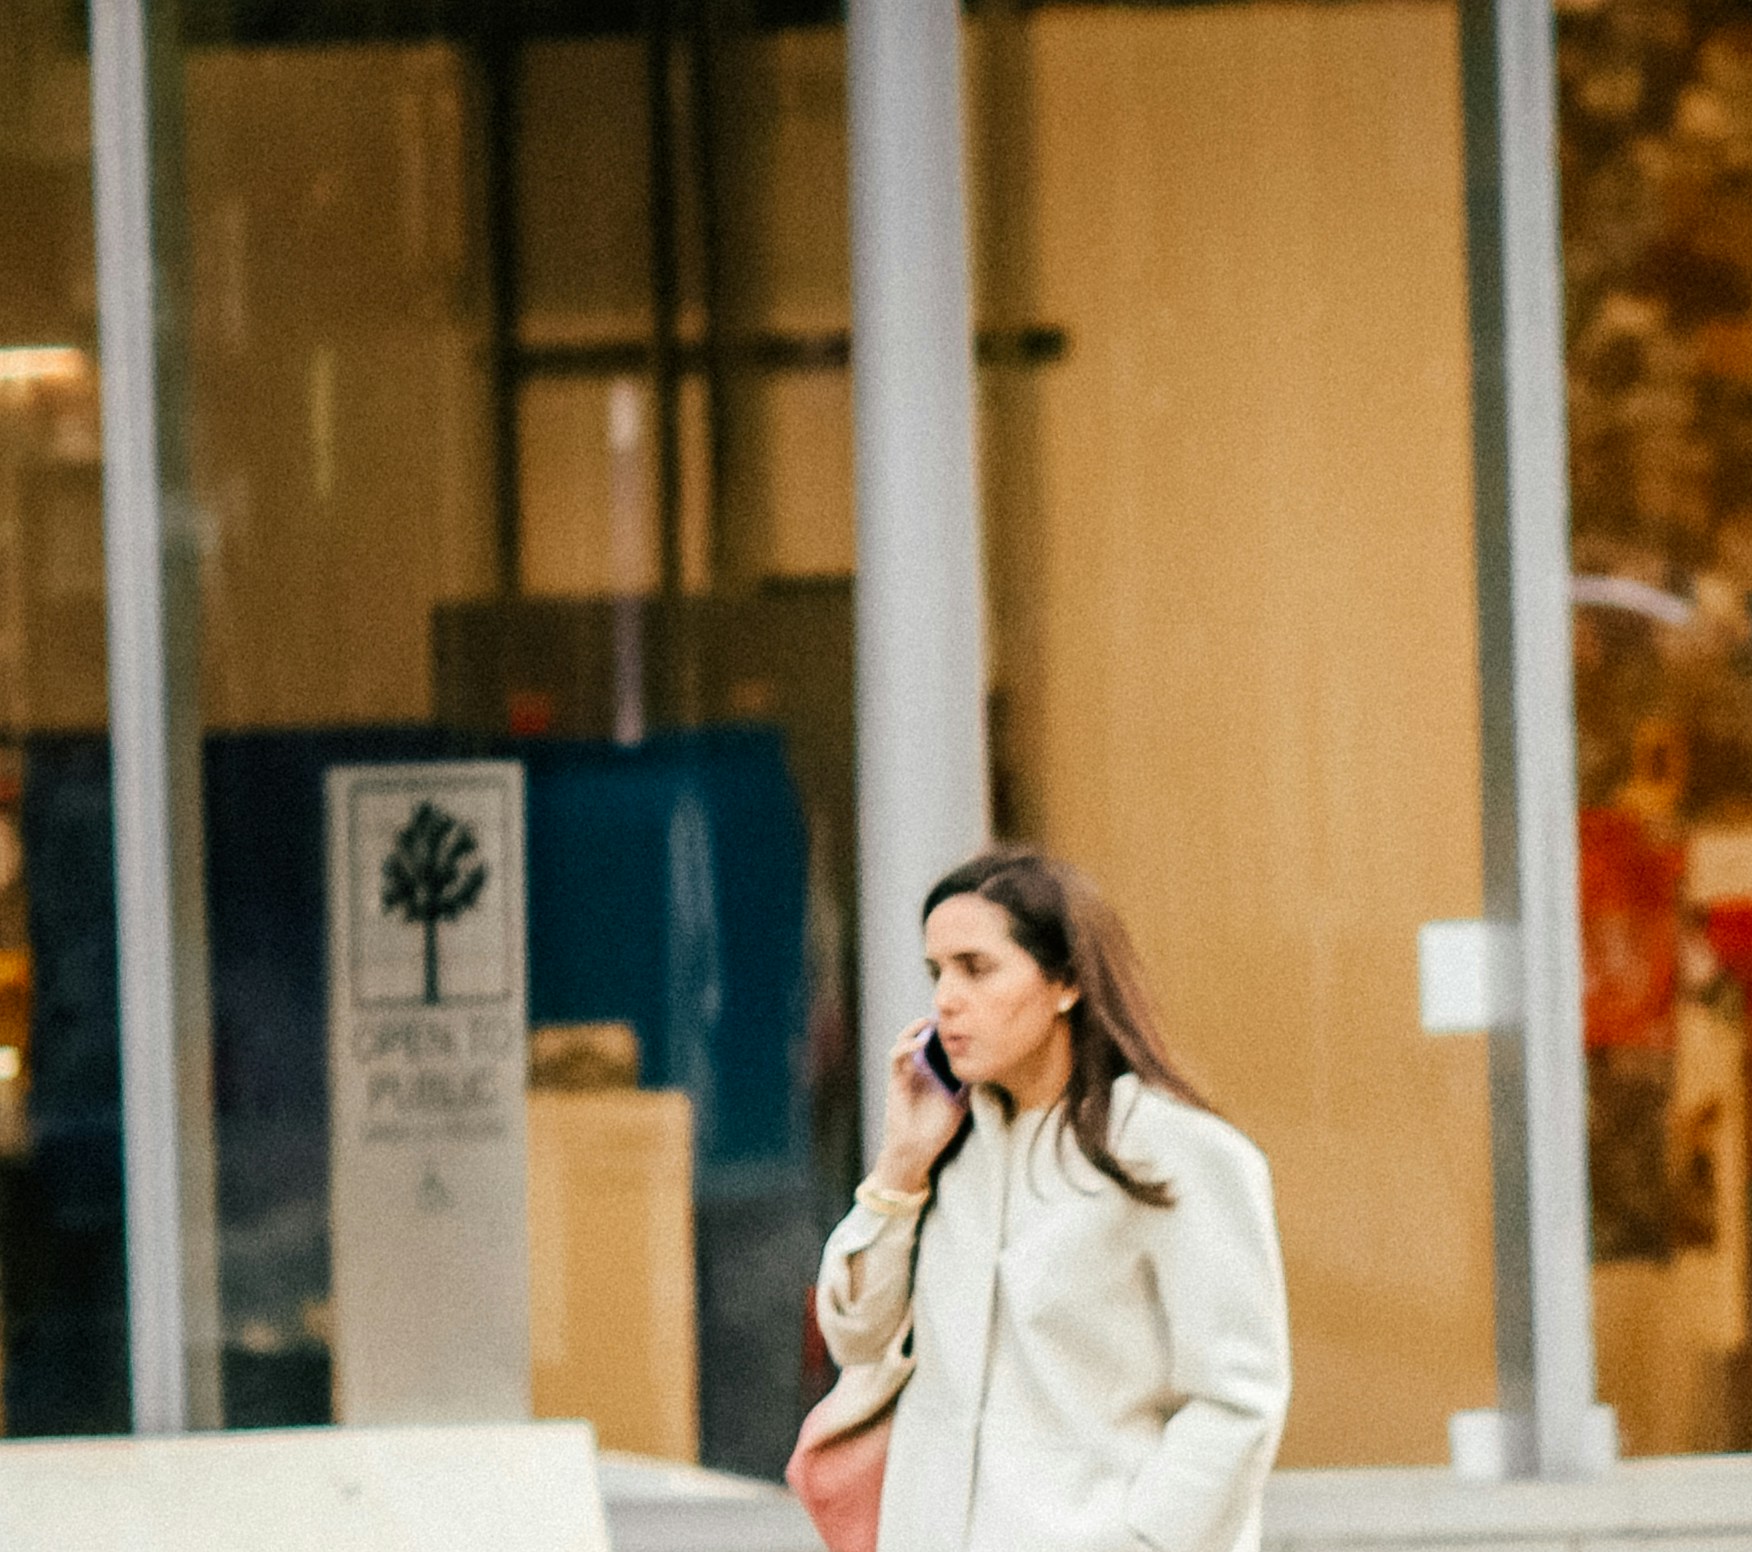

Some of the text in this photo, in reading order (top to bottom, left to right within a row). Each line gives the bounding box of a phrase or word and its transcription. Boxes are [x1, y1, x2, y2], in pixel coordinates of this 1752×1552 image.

[351, 1016, 512, 1062] OPEN TO
[369, 1067, 498, 1112] PUBLIC
